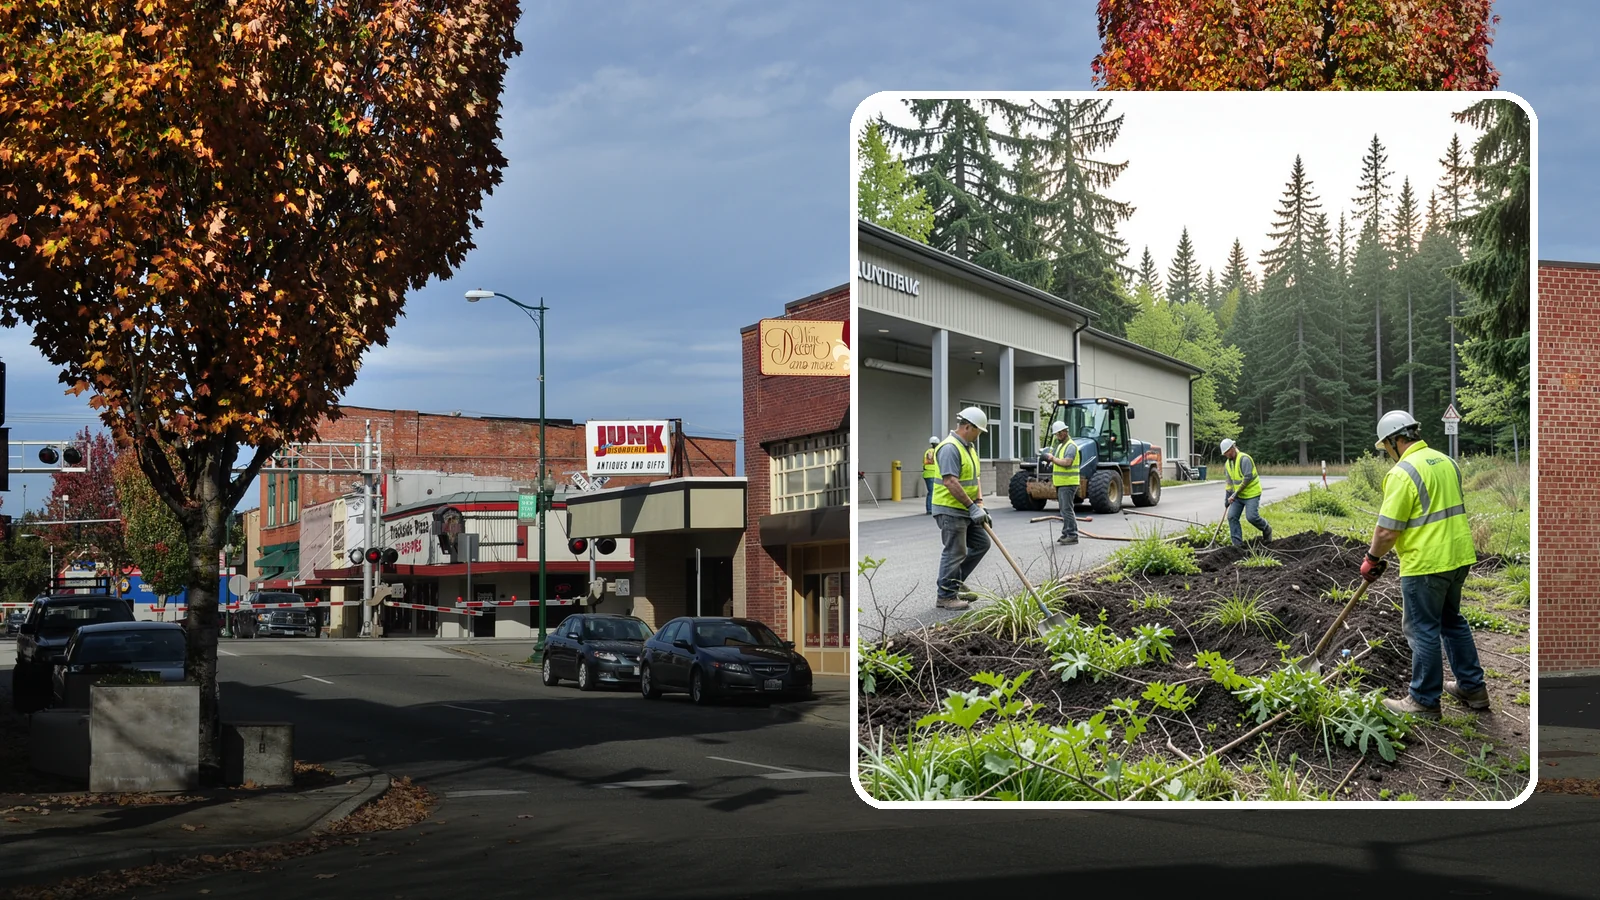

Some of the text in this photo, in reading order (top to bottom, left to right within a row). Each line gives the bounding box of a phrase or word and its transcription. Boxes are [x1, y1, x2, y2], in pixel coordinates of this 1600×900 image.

[596, 425, 665, 457] JUNK
[607, 446, 646, 454] DISORDERLY
[597, 460, 665, 470] ANTIQUES AND GIFTS
[415, 520, 429, 534] Pizza
